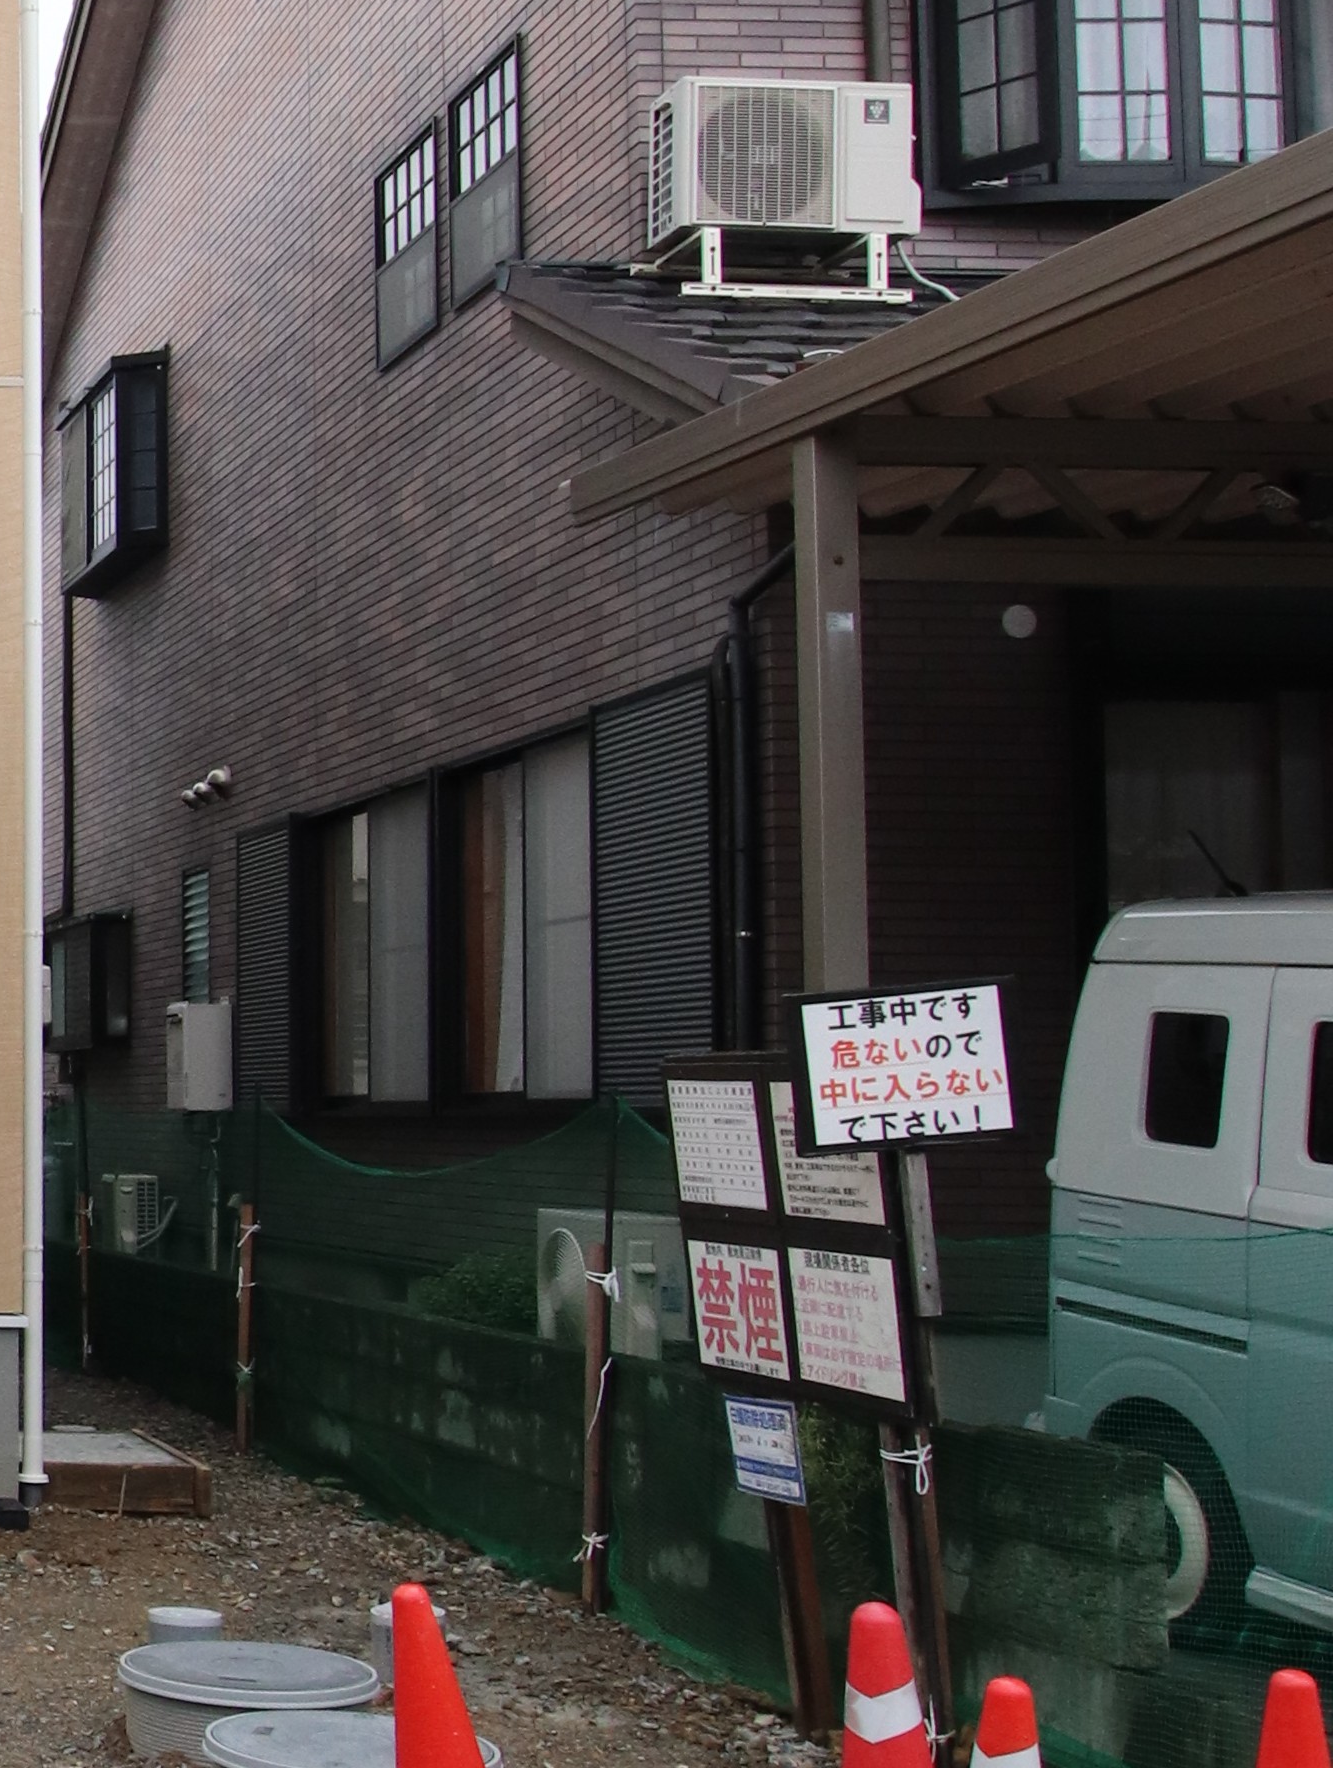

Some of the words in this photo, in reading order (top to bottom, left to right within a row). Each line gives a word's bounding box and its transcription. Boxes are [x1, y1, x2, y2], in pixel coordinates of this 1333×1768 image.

[828, 992, 977, 1030] 工事中です
[830, 1030, 982, 1070] 危ないので
[820, 1068, 1003, 1108] 中に入らない
[696, 1257, 784, 1363] 禁煙
